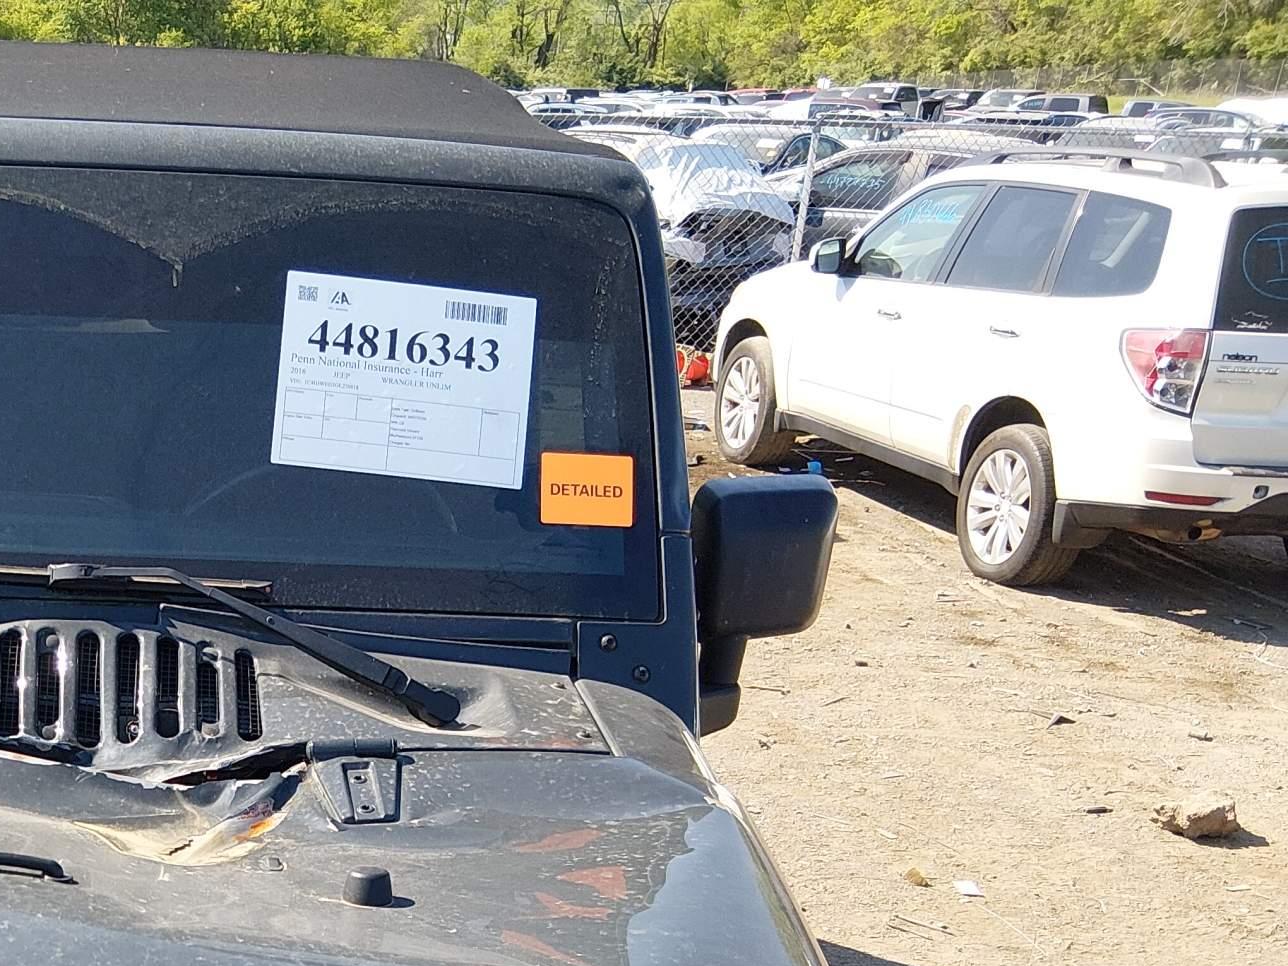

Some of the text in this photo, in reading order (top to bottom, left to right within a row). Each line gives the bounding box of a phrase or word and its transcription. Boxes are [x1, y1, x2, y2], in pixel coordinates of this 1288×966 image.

[307, 319, 500, 373] 44816343
[290, 352, 316, 366] Penn
[318, 355, 360, 370] National
[363, 360, 411, 376] Insurance
[421, 366, 444, 379] Harr
[381, 376, 424, 388] WRANGLER
[426, 381, 452, 392] UNLIM
[550, 482, 624, 499] DETAILED
